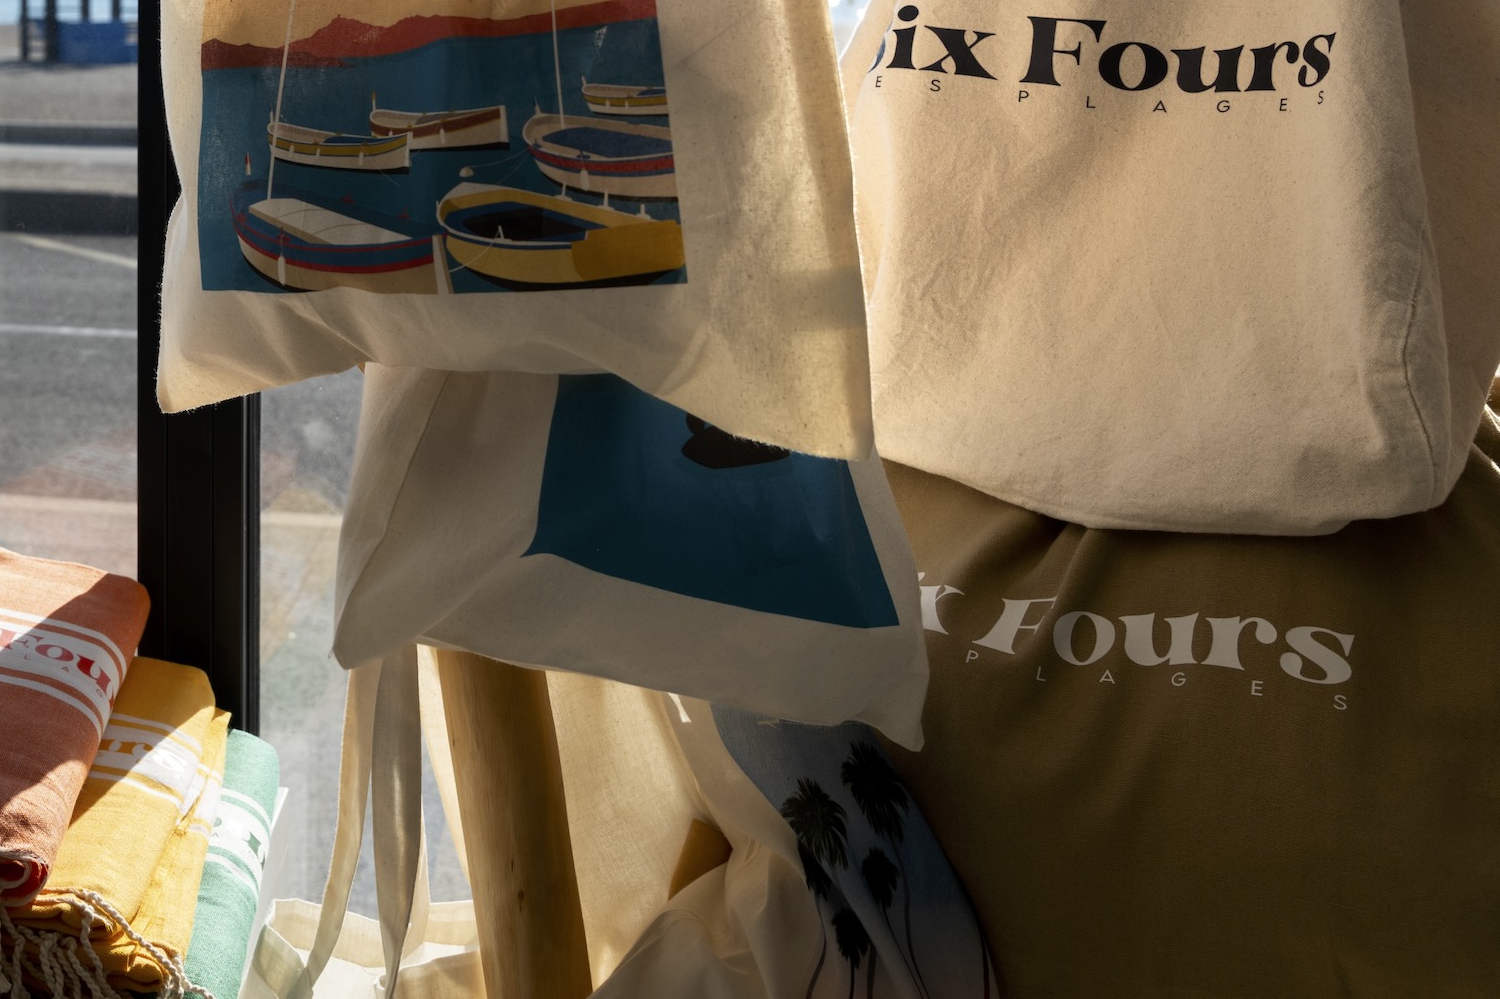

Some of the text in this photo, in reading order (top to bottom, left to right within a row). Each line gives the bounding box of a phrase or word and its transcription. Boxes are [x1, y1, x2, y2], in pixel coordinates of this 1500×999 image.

[868, 4, 1337, 93] ix Fours
[1018, 88, 1325, 113] PLAGES
[972, 595, 1356, 685] Fours
[965, 648, 1348, 711] PLAGES
